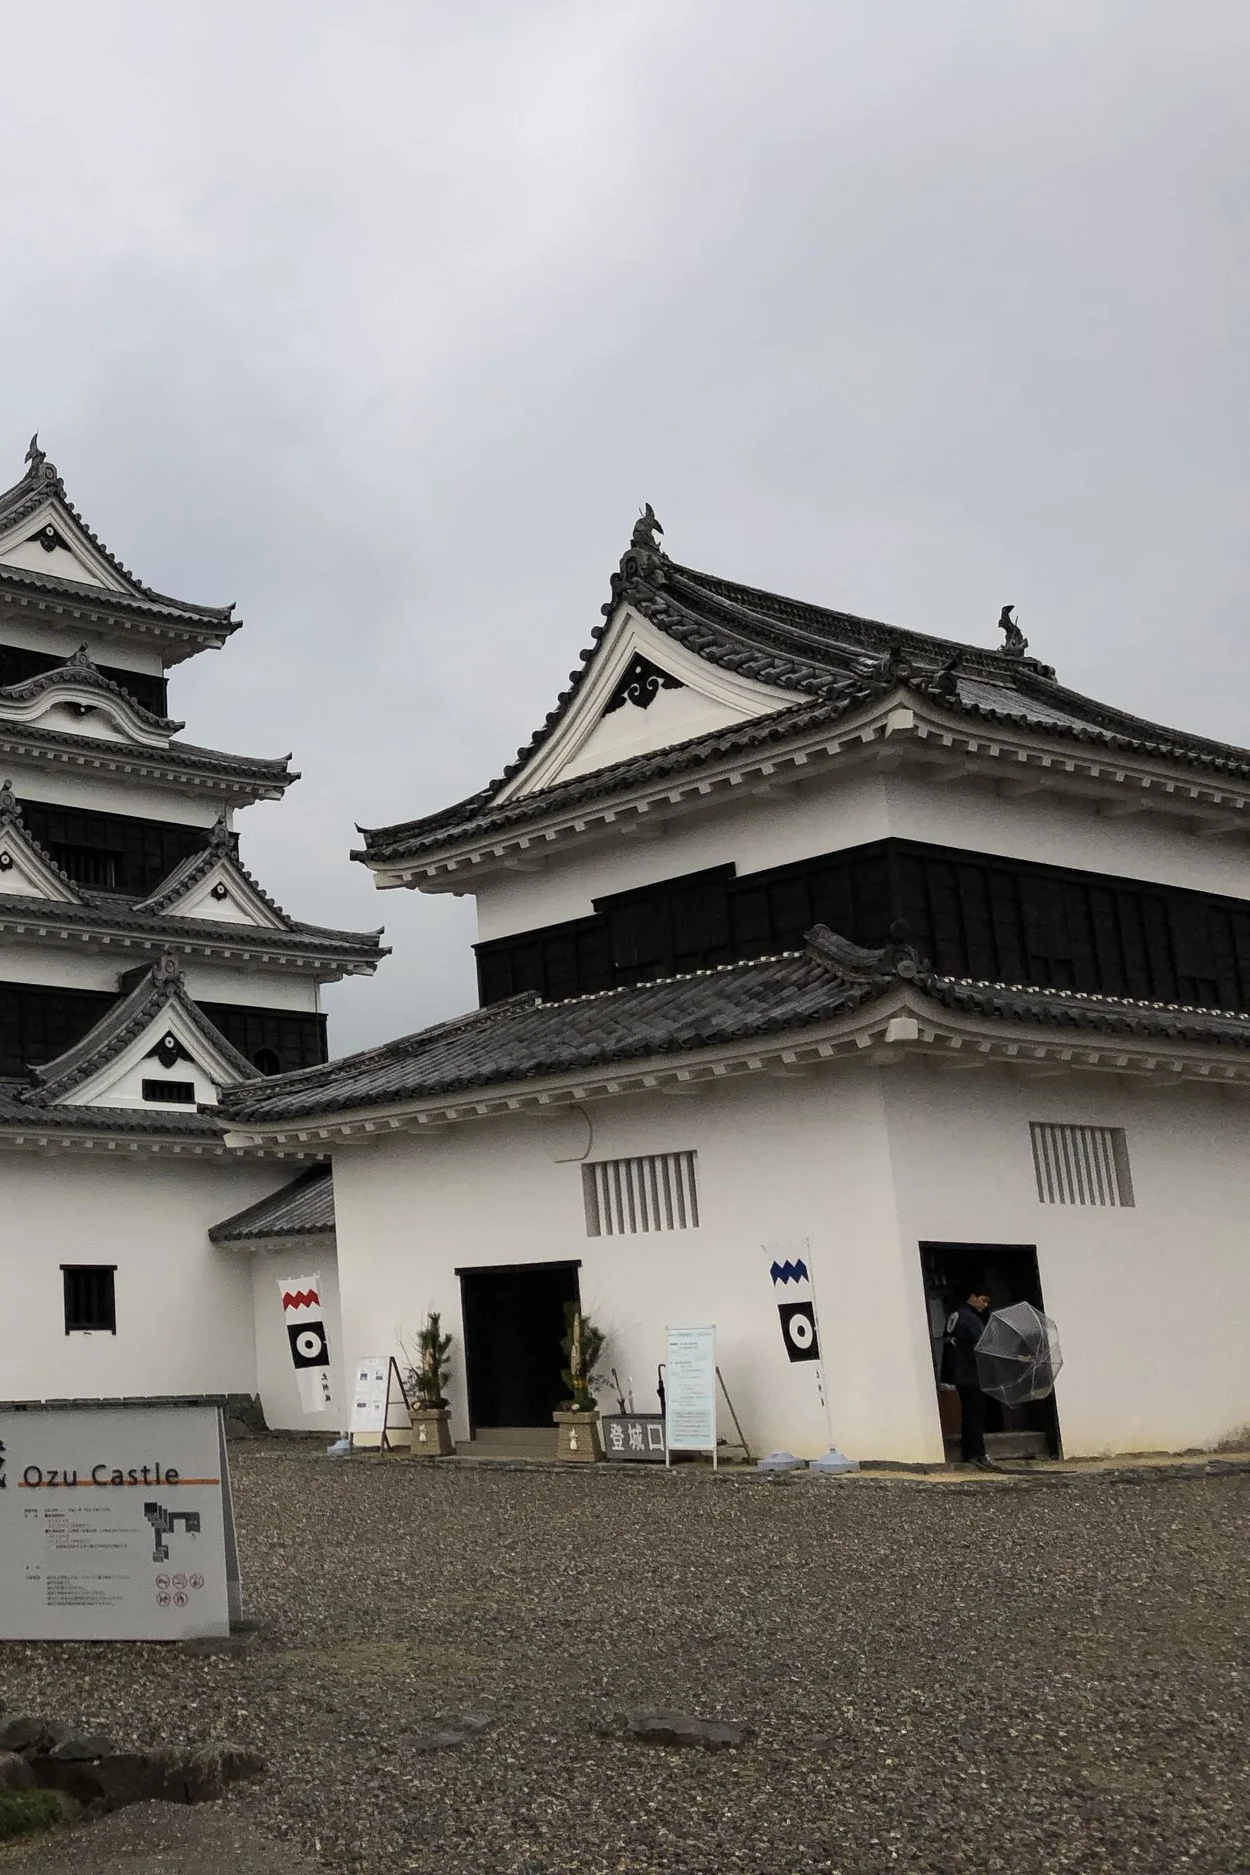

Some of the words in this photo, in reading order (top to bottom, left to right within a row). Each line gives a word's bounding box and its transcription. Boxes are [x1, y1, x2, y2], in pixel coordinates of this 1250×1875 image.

[610, 1423, 665, 1451] 登城口
[23, 1465, 78, 1487] Ozu
[91, 1461, 180, 1487] Castle
